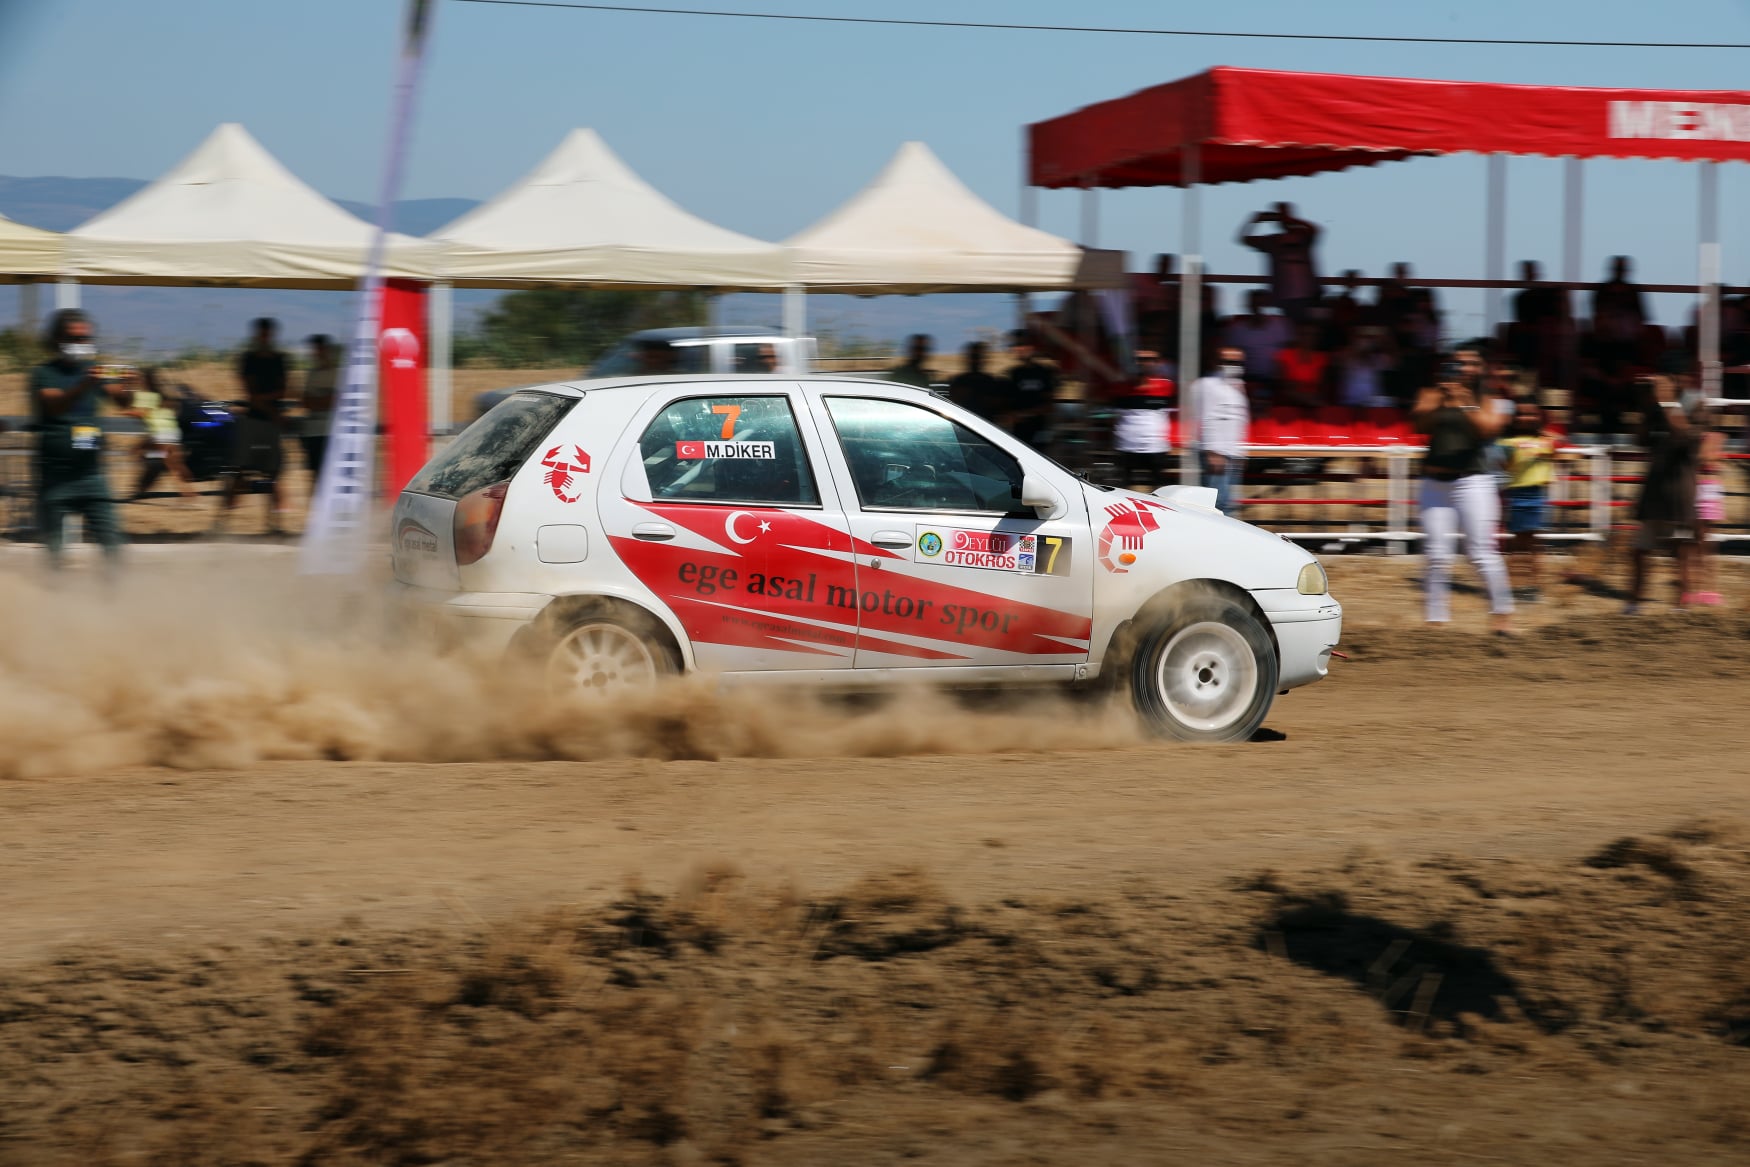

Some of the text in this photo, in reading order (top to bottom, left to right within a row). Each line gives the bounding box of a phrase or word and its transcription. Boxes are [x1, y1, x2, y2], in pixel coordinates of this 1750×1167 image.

[712, 405, 741, 439] 7
[707, 442, 773, 458] M.DİKER
[945, 551, 1015, 569] OTOKROS
[1045, 537, 1062, 573] 7
[678, 562, 1019, 634] ege asal motor spor
